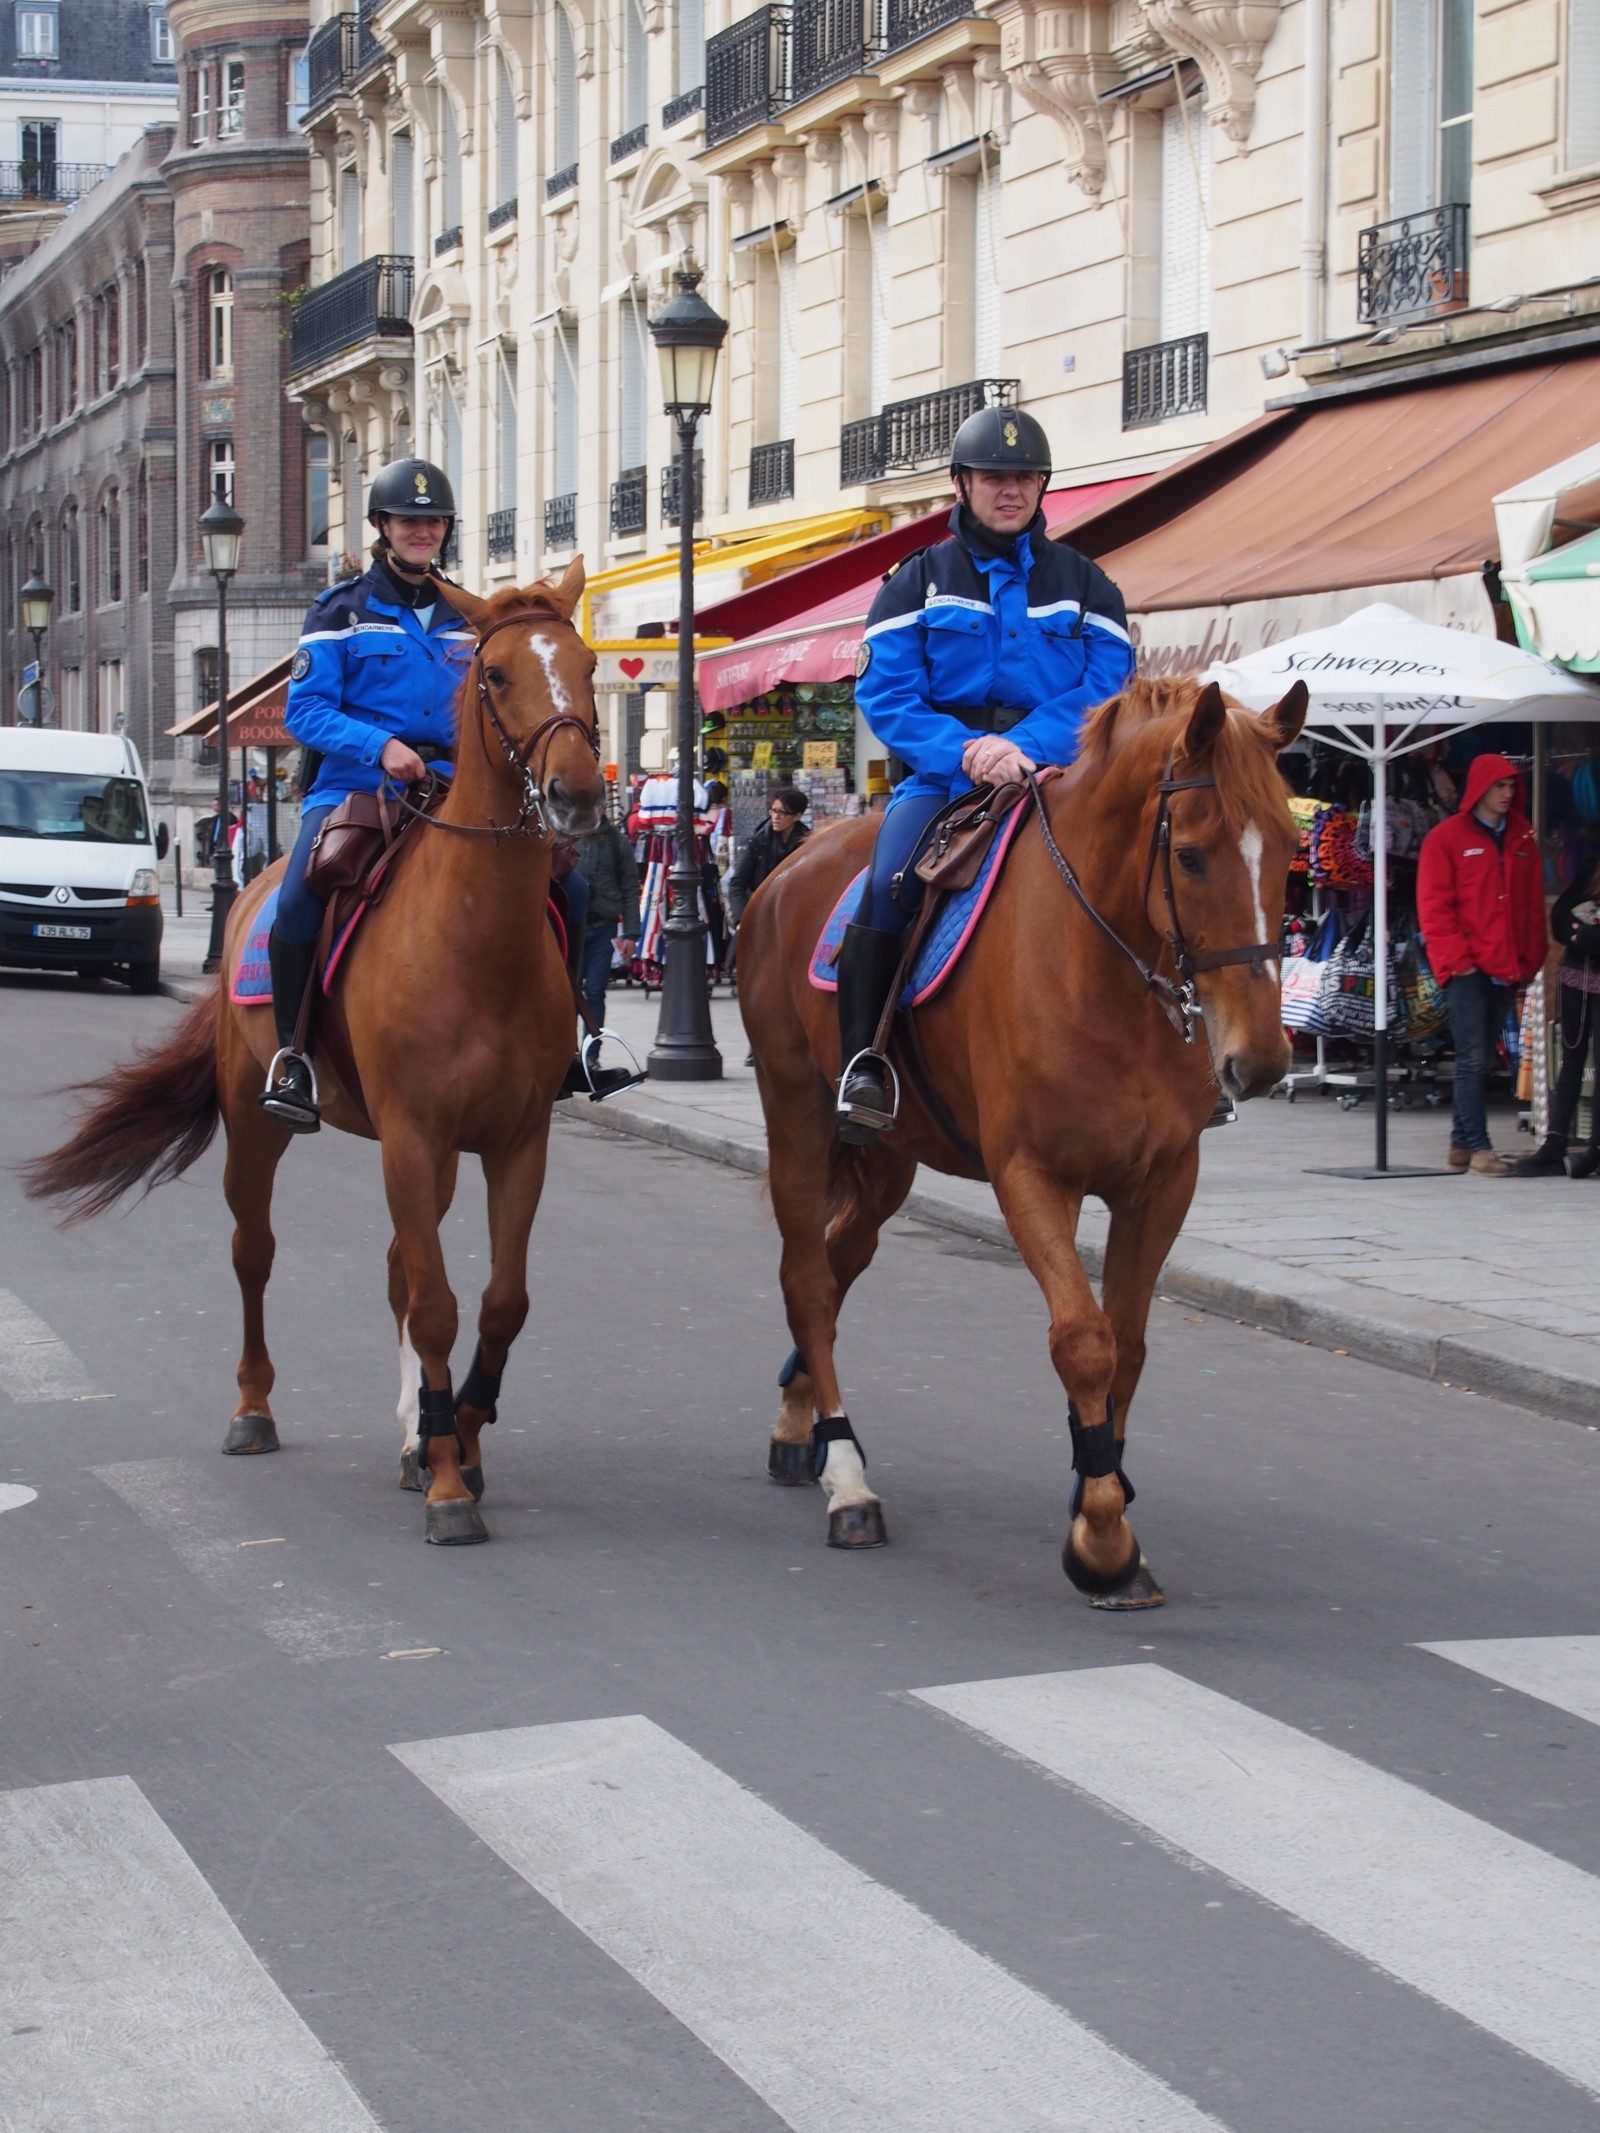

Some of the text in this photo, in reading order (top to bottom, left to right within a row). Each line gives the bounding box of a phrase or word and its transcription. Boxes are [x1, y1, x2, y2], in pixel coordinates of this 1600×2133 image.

[353, 624, 394, 633] GENDARMERIE
[1272, 651, 1447, 677] Schweppes
[253, 705, 287, 720] POR
[239, 726, 294, 740] BOOK
[78, 929, 89, 939] 75
